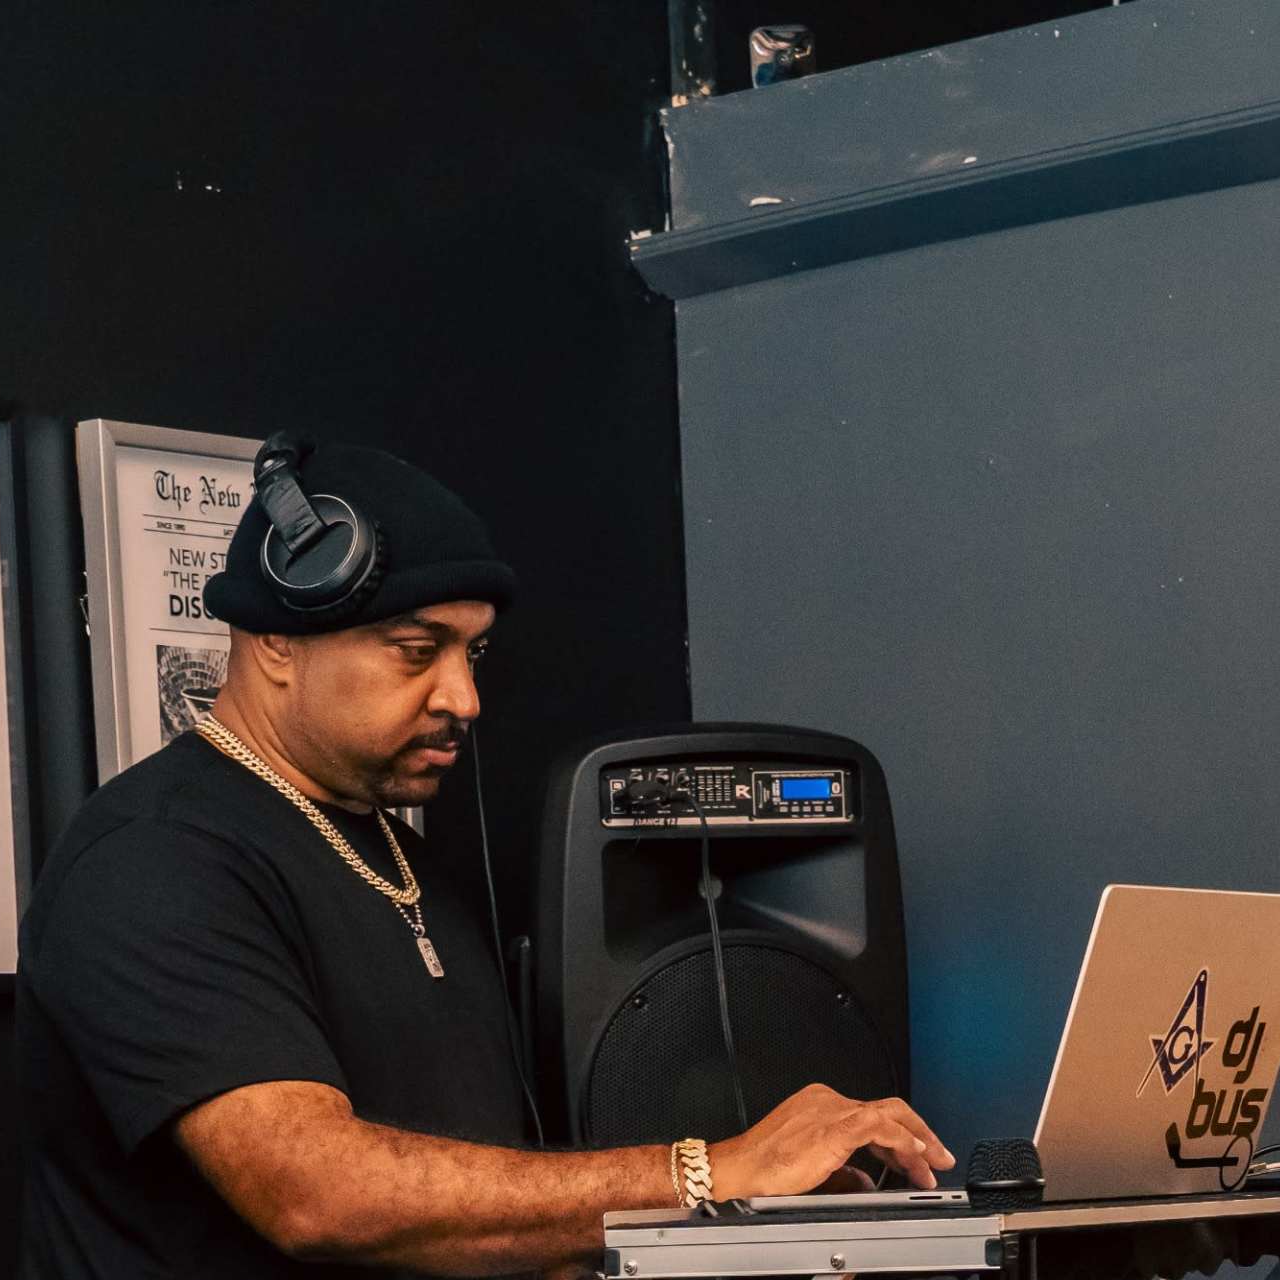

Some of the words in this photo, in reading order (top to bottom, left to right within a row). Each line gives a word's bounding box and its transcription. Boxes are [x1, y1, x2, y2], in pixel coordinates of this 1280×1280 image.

[153, 470, 191, 511] The
[199, 475, 241, 515] New
[169, 547, 206, 568] NEW
[1221, 1005, 1266, 1084] dj
[1185, 1078, 1269, 1139] bus
